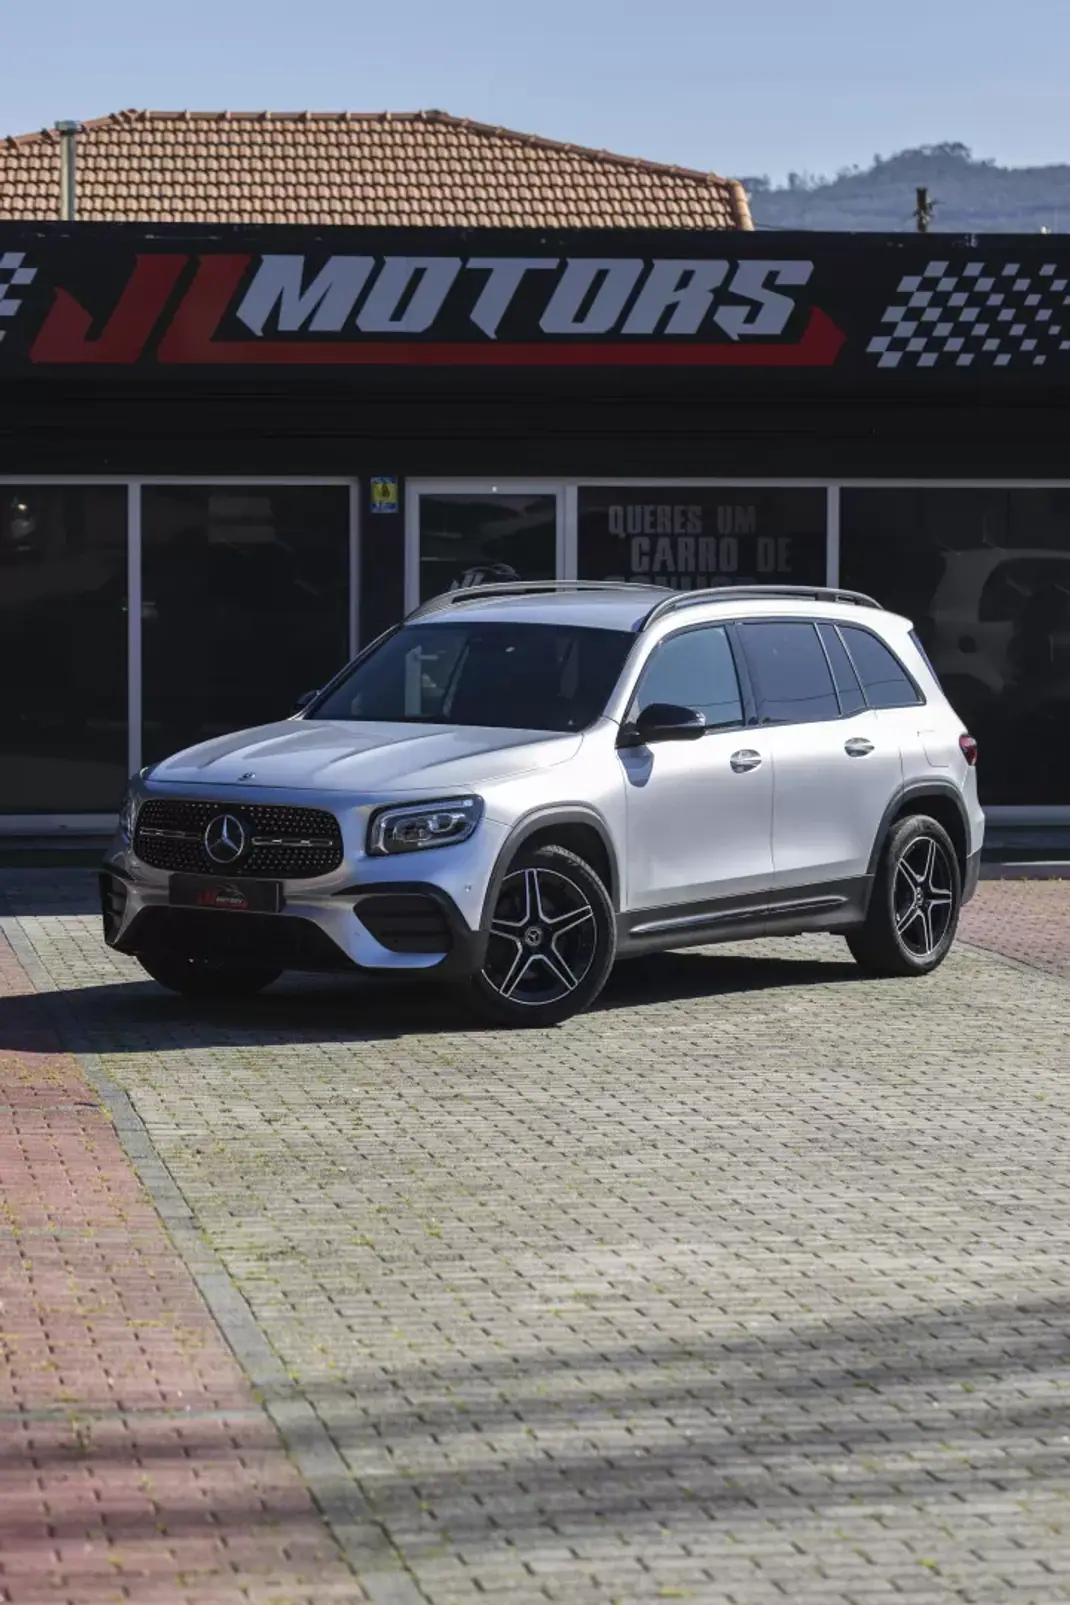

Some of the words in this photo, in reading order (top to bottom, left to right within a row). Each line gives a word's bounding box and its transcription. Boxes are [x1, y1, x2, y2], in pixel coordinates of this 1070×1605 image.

[236, 254, 815, 341] MOTORS
[608, 505, 703, 539] QUERES
[717, 505, 757, 535] UM
[630, 536, 738, 573] CARRO
[756, 536, 793, 573] DE
